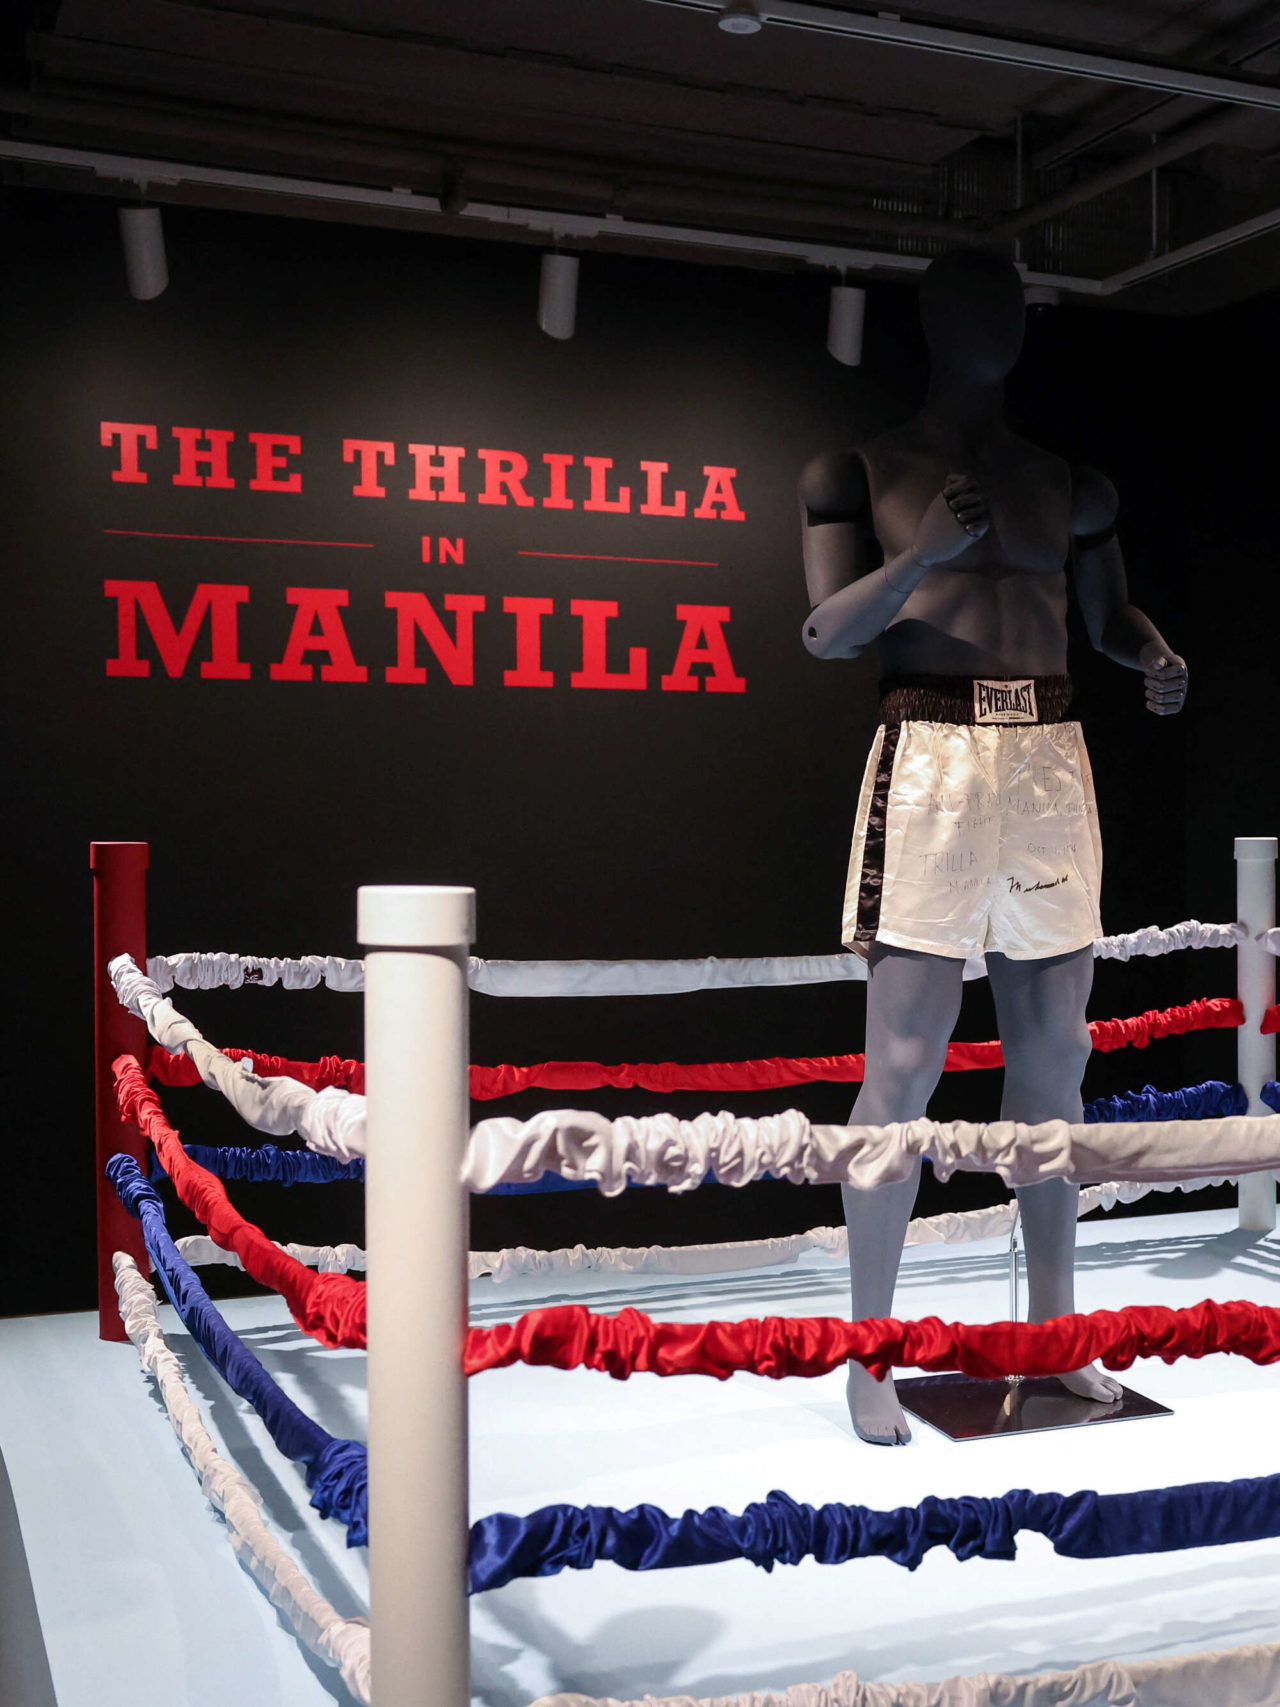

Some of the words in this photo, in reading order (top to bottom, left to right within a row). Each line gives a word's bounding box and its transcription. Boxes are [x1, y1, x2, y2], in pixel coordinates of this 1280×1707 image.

[100, 421, 303, 493] THE
[343, 439, 746, 521] THRILLA
[422, 536, 464, 565] IN
[104, 579, 746, 693] MANILA
[977, 682, 1034, 718] EVERLAST
